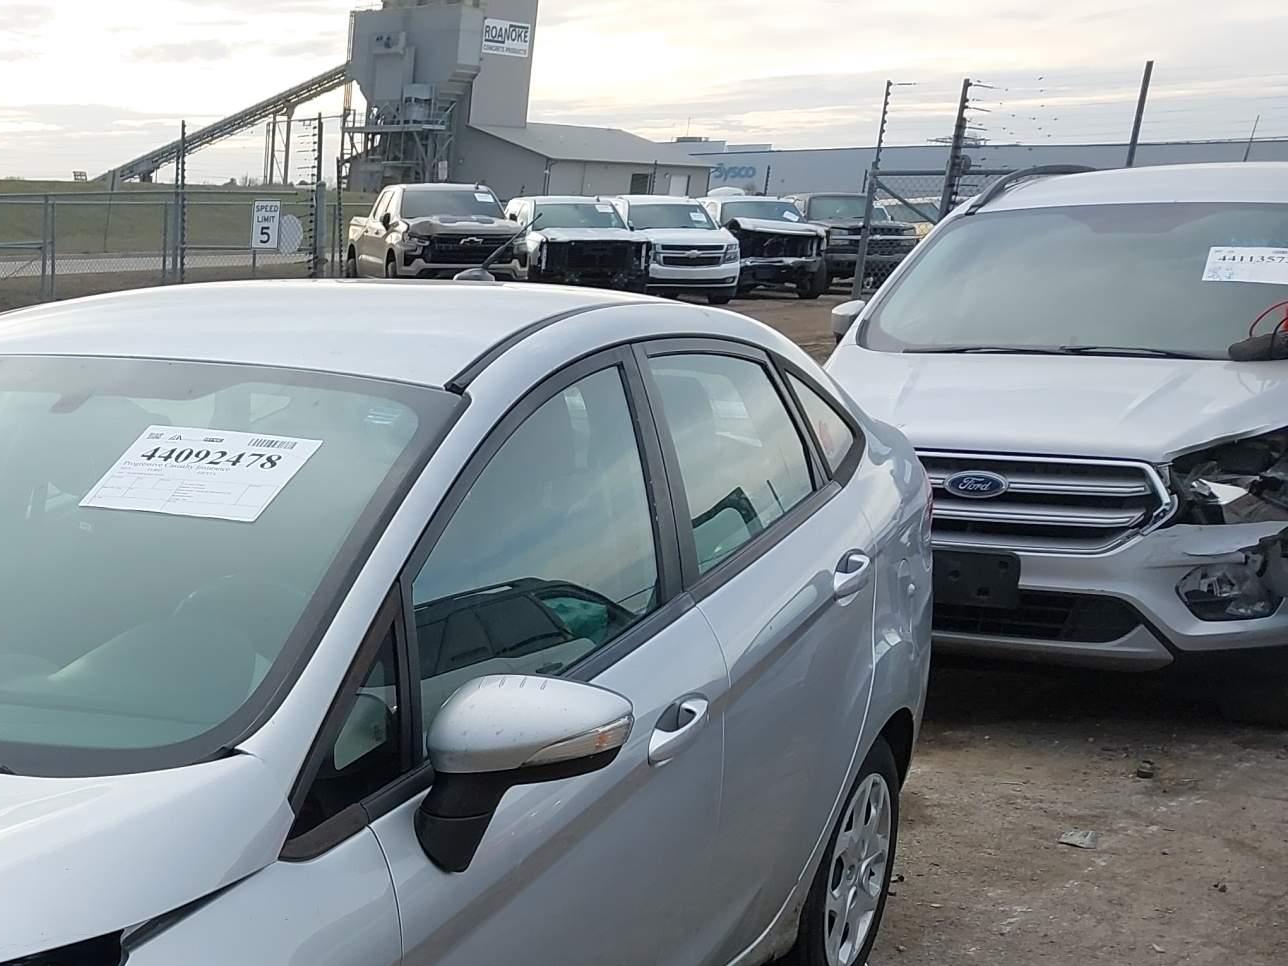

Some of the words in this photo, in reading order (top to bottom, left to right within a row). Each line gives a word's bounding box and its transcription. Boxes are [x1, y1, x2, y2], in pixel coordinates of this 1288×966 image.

[484, 24, 529, 44] ROANOKE
[255, 204, 279, 213] SPEED
[256, 215, 275, 223] LIMIT
[259, 225, 271, 244] 5
[1217, 255, 1288, 264] 4411357
[140, 446, 283, 470] 44092478
[958, 477, 992, 491] Ford
